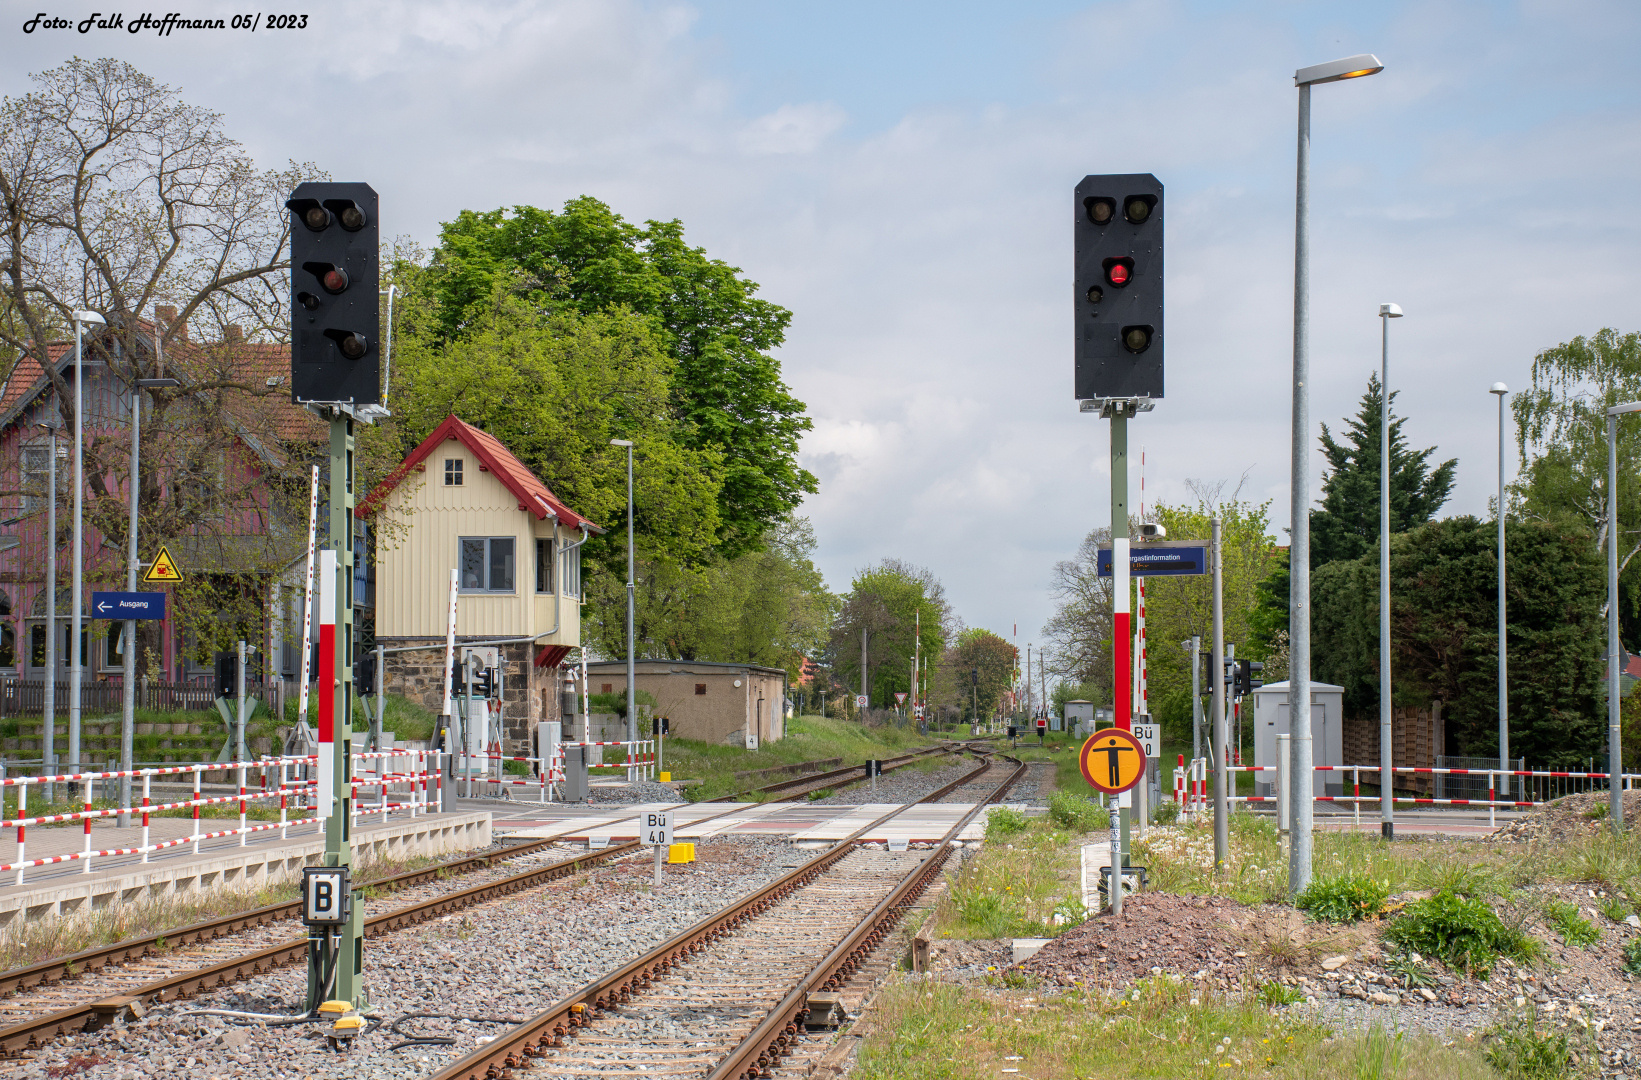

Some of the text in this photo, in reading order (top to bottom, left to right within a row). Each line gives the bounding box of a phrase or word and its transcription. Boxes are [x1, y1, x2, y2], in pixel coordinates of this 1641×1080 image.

[1129, 554, 1180, 562] rgastinformation
[119, 600, 149, 609] Ausgang
[1134, 726, 1153, 739] Bü
[1145, 743, 1152, 756] 0
[648, 814, 666, 827] Bü
[648, 830, 665, 844] 4,0
[315, 881, 333, 912] B
